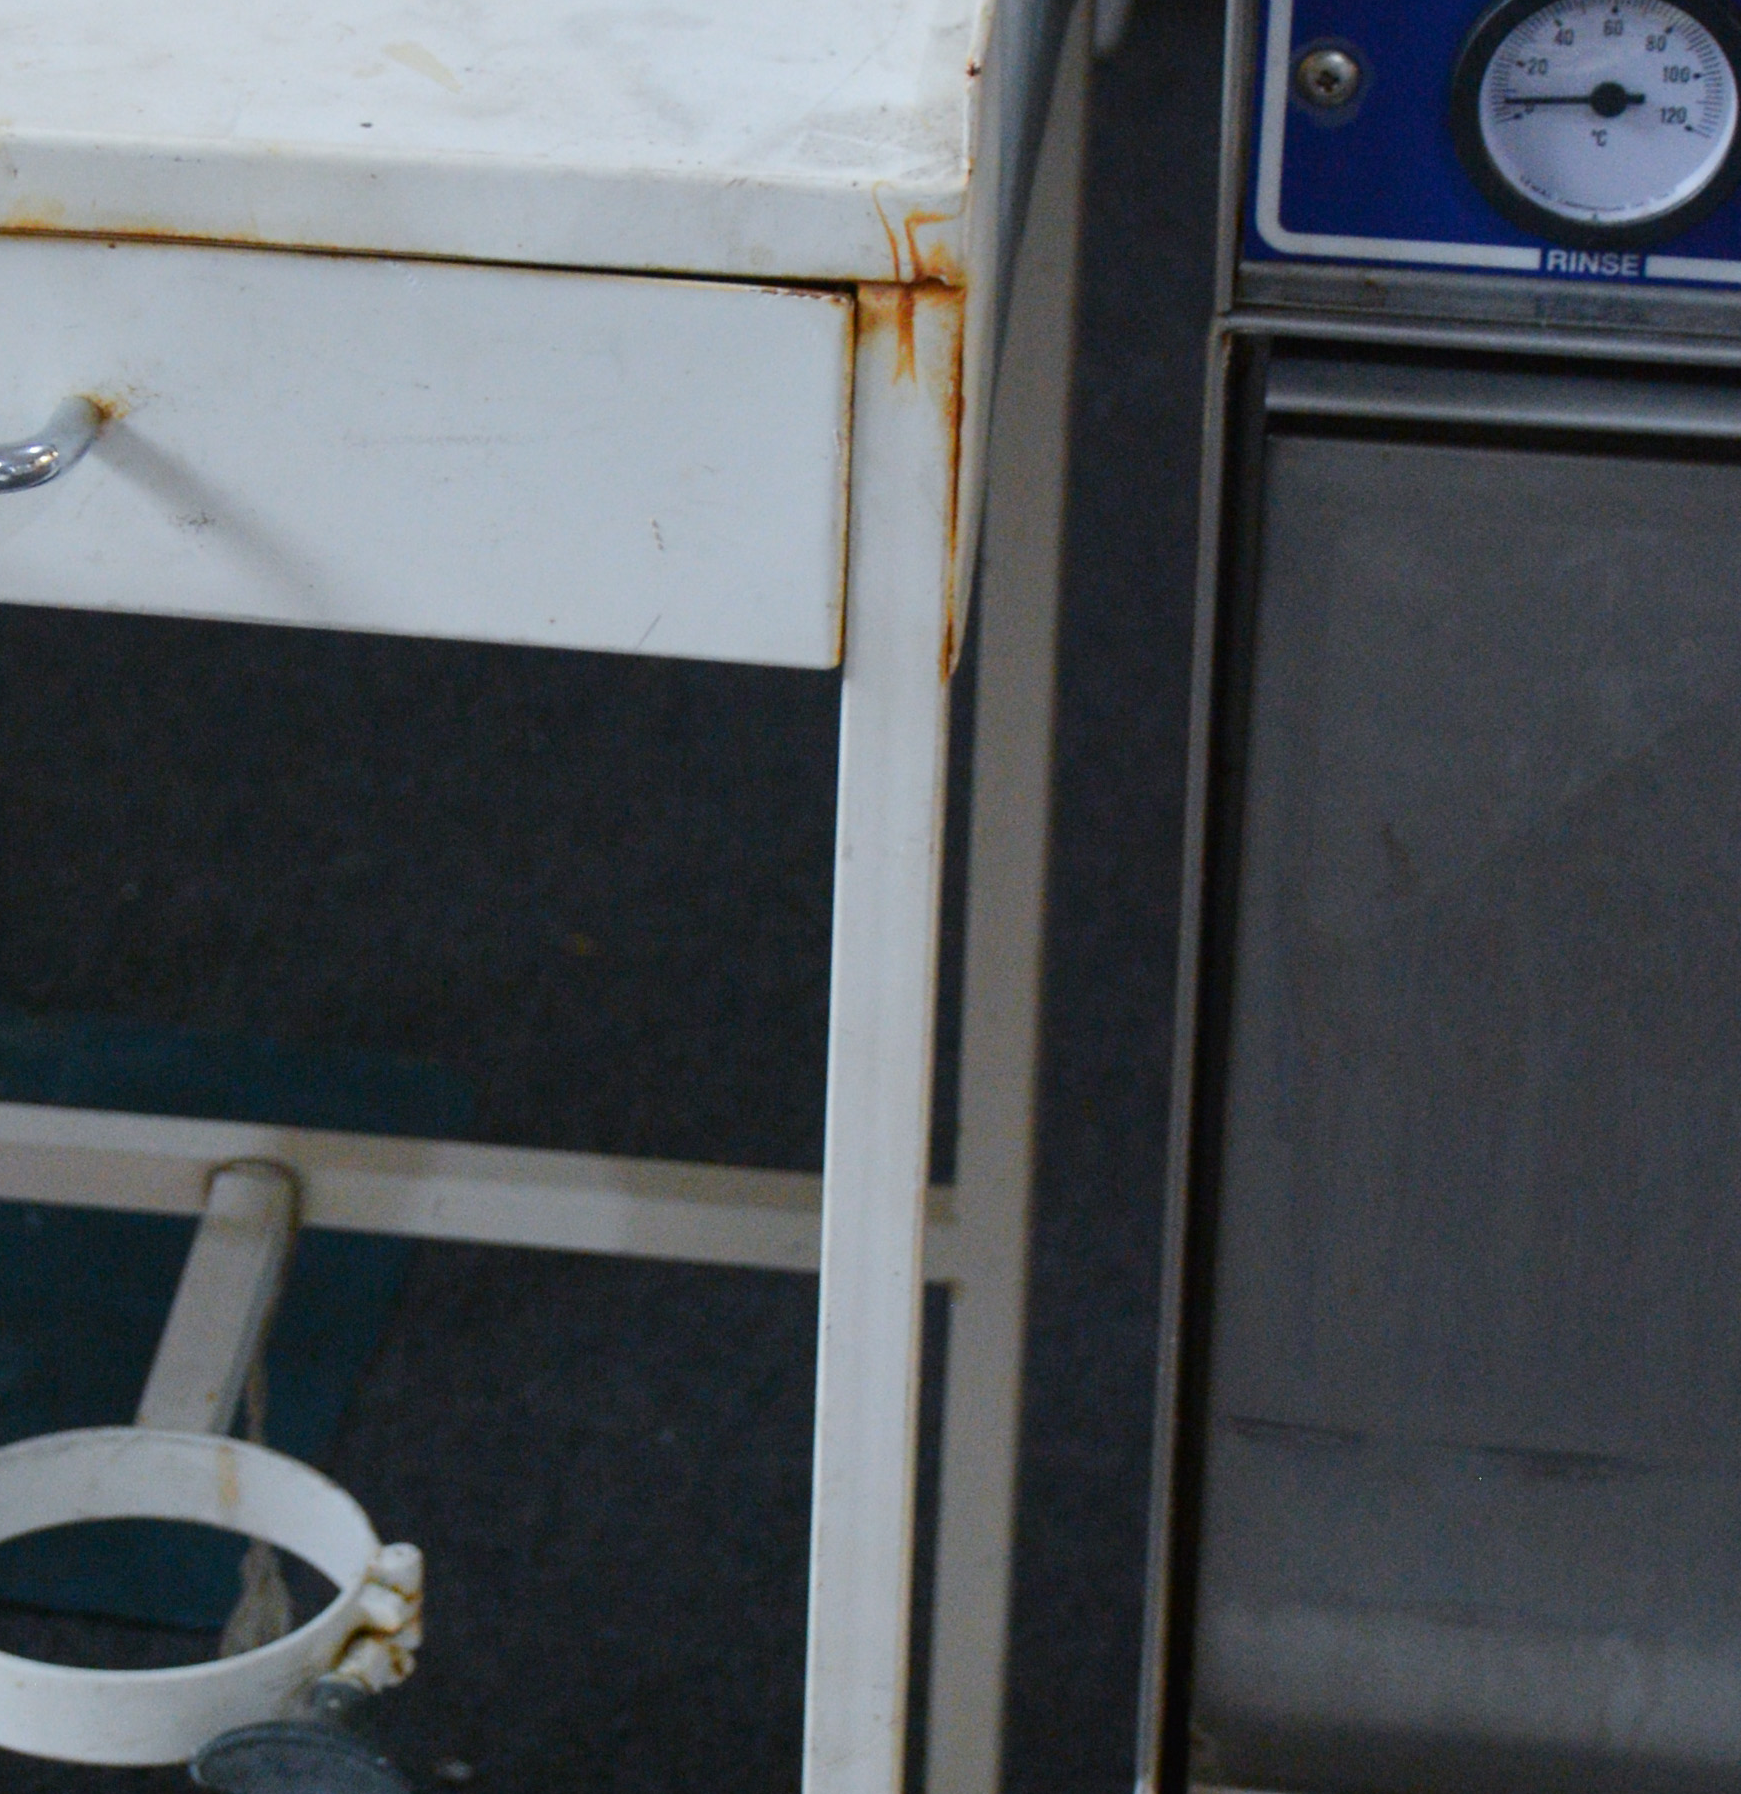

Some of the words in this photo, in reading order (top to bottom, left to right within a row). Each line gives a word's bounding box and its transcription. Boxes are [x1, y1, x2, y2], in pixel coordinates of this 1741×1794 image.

[1603, 19, 1624, 36] 60
[1554, 29, 1575, 46] 40
[1645, 34, 1667, 52] 80
[1527, 58, 1549, 75] 20
[1663, 65, 1691, 83] 100
[1661, 107, 1687, 125] 120
[1546, 249, 1643, 277] RINSE
